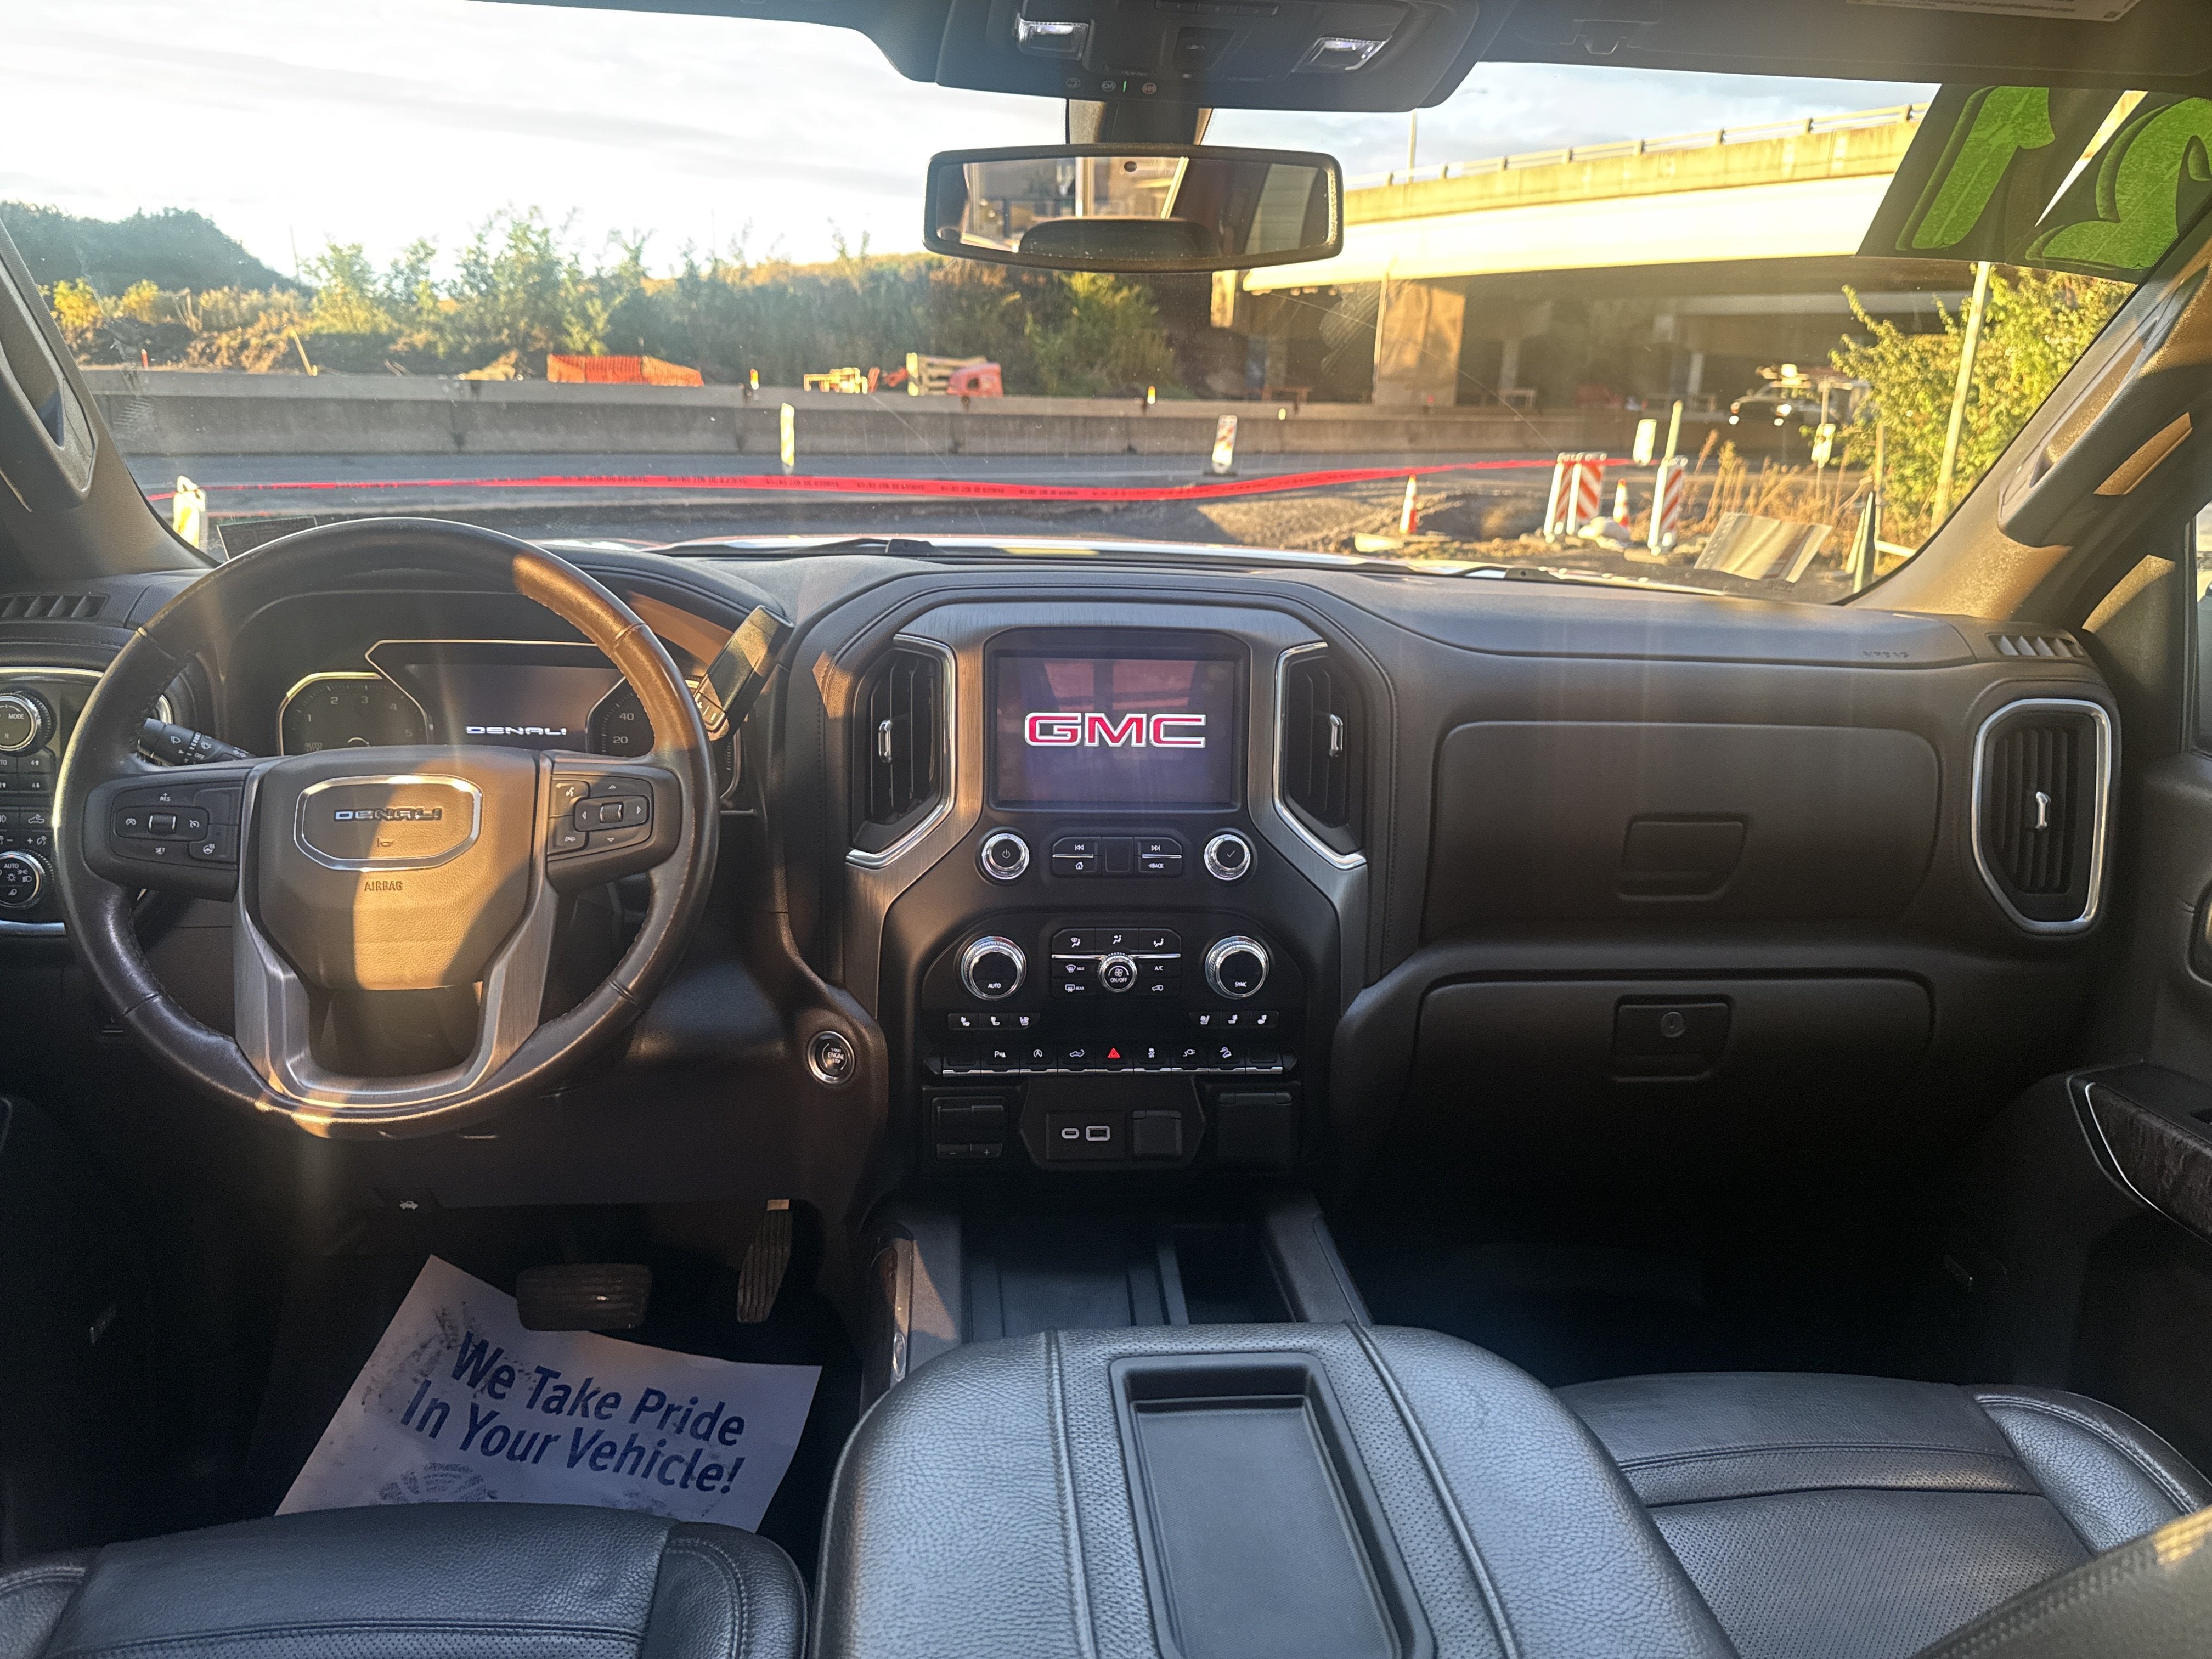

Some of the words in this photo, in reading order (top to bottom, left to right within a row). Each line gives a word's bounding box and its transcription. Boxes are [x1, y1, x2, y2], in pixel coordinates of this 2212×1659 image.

[361, 696, 368, 704] 3
[466, 726, 567, 735] DENALI
[1025, 712, 1206, 748] GMC
[613, 736, 628, 744] 20
[334, 808, 442, 821] DENALI
[364, 880, 403, 892] AIRBAG
[827, 1052, 845, 1060] ENGINE
[452, 1331, 516, 1400] We
[524, 1364, 622, 1420] Take
[629, 1386, 746, 1447] Pride
[400, 1379, 451, 1439] In
[459, 1401, 561, 1465] Your
[565, 1427, 746, 1495] Vehicle!
